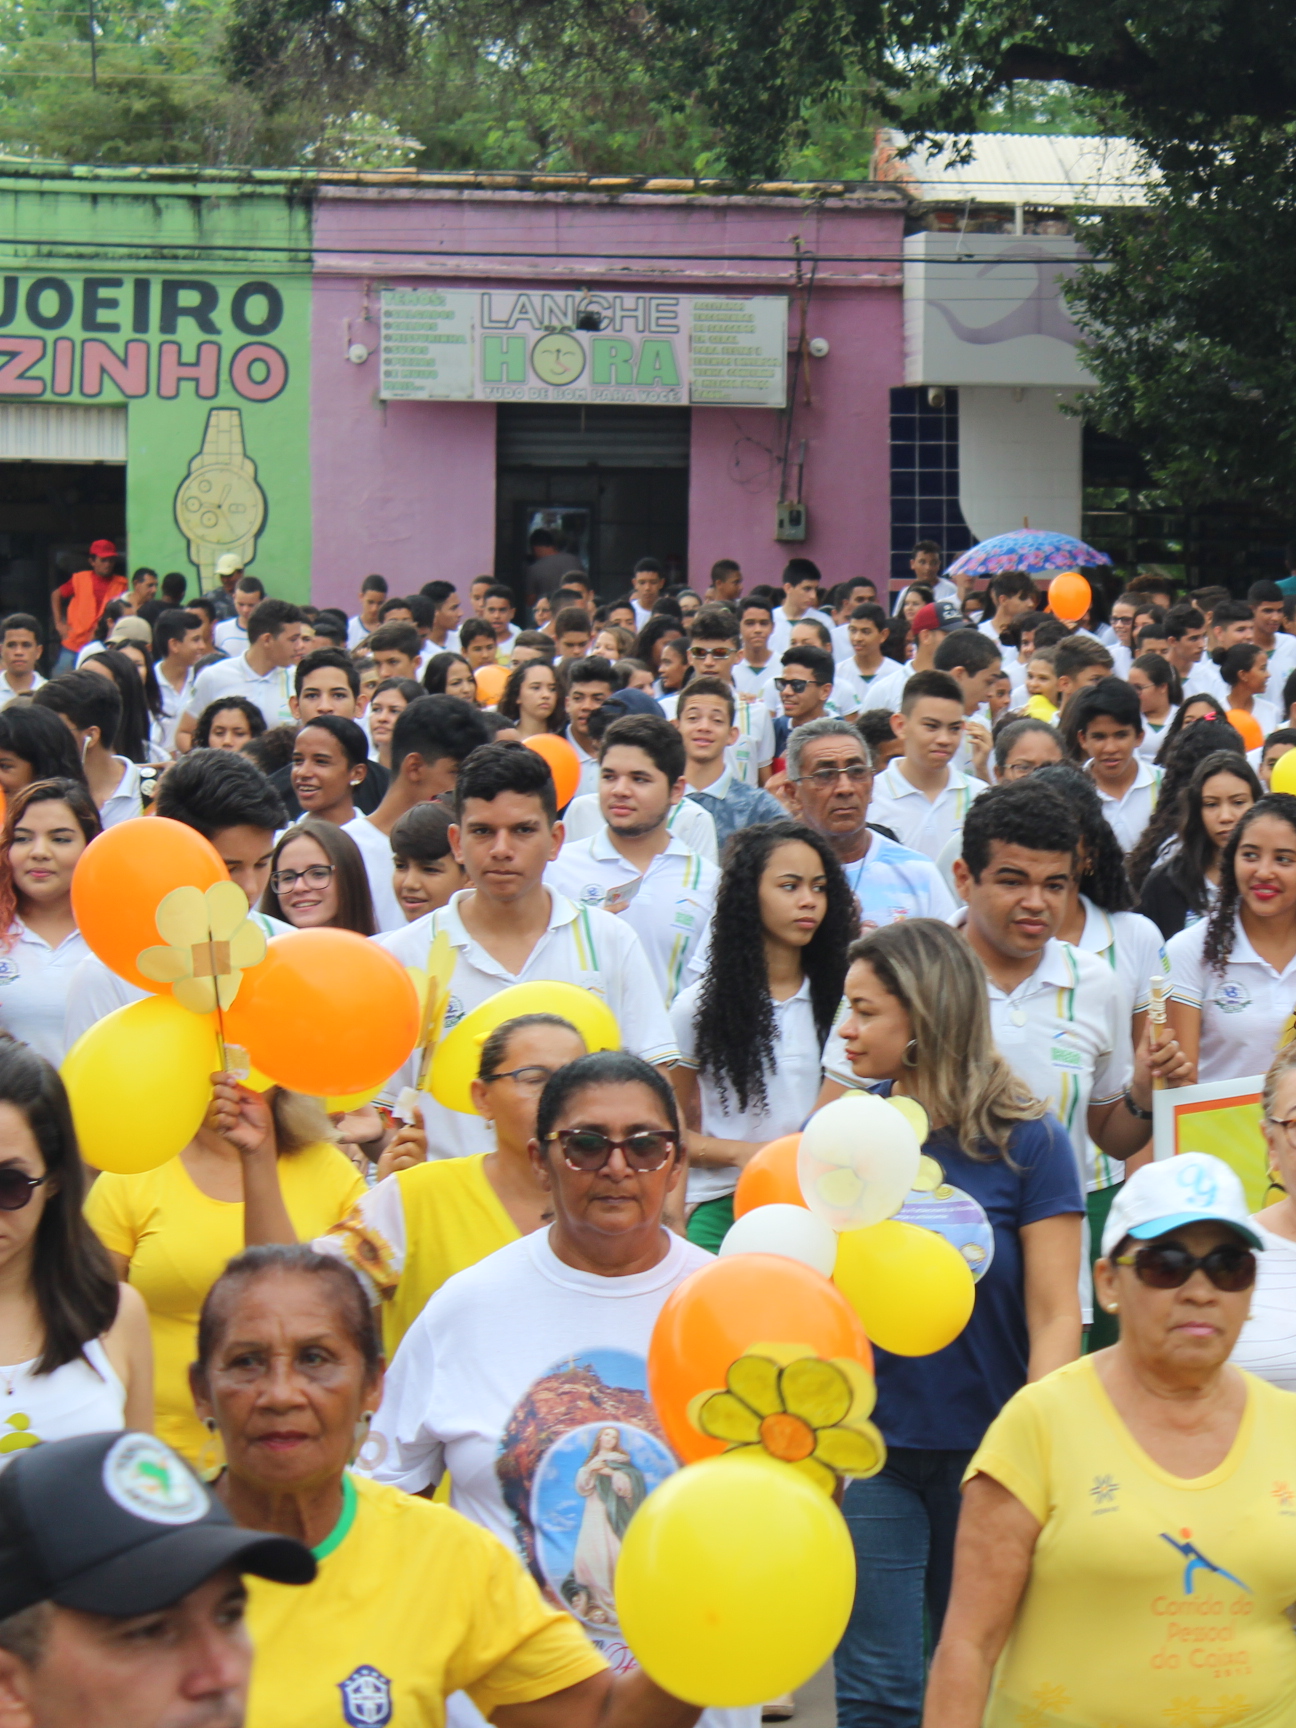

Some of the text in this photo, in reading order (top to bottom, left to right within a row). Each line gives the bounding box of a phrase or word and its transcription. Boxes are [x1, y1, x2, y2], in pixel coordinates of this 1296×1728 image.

[481, 292, 680, 333] LANCHE
[483, 386, 525, 400] TUDO
[529, 387, 549, 400] DE
[553, 387, 588, 401] BOM
[592, 388, 636, 402] PARA
[1151, 1594, 1225, 1616] Corrida
[1167, 1620, 1237, 1643] Pessoal
[1150, 1646, 1248, 1670] da Caixa
